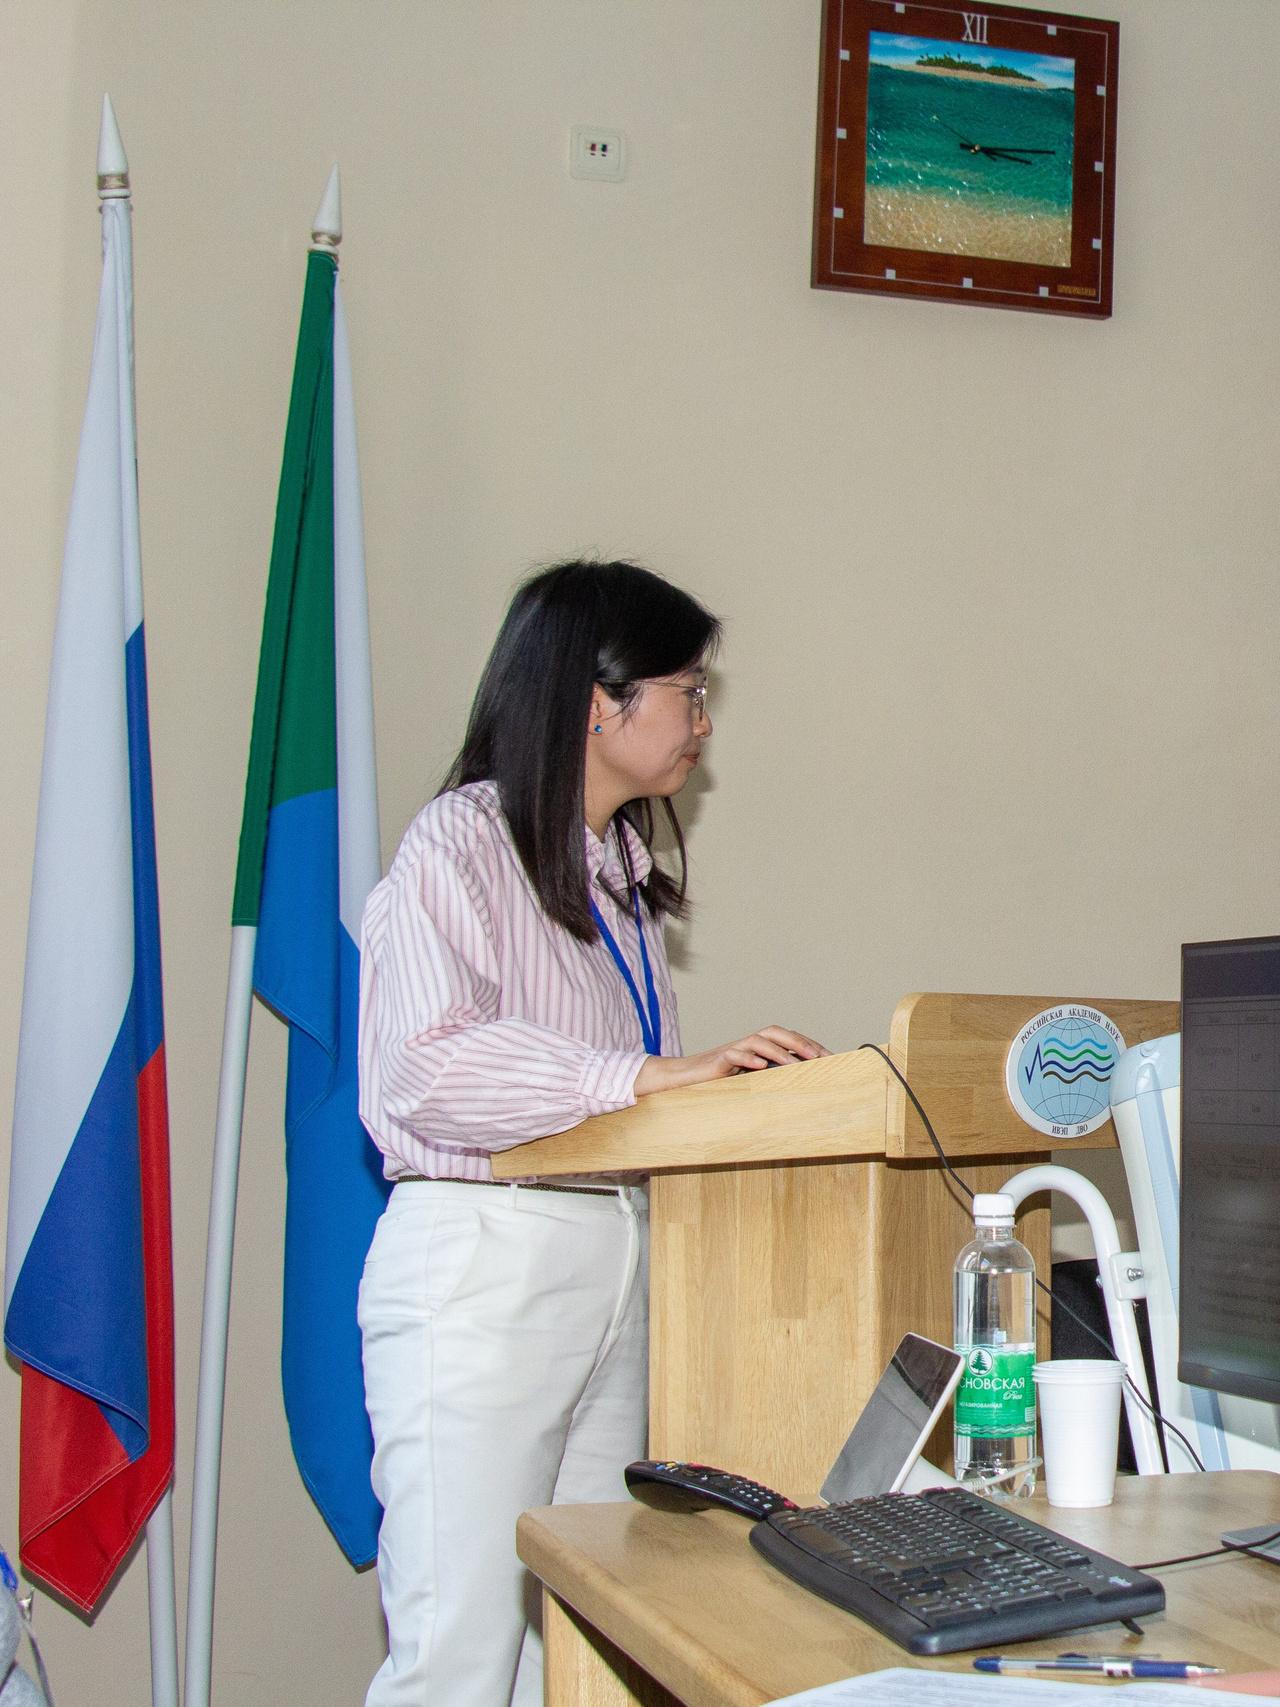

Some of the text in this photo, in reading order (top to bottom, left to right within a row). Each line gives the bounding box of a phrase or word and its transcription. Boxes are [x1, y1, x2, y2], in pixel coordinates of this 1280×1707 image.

[962, 12, 988, 45] XII
[1020, 1008, 1121, 1044] РОССИЙСКАЯ АКАДЕМИЯ НАУК
